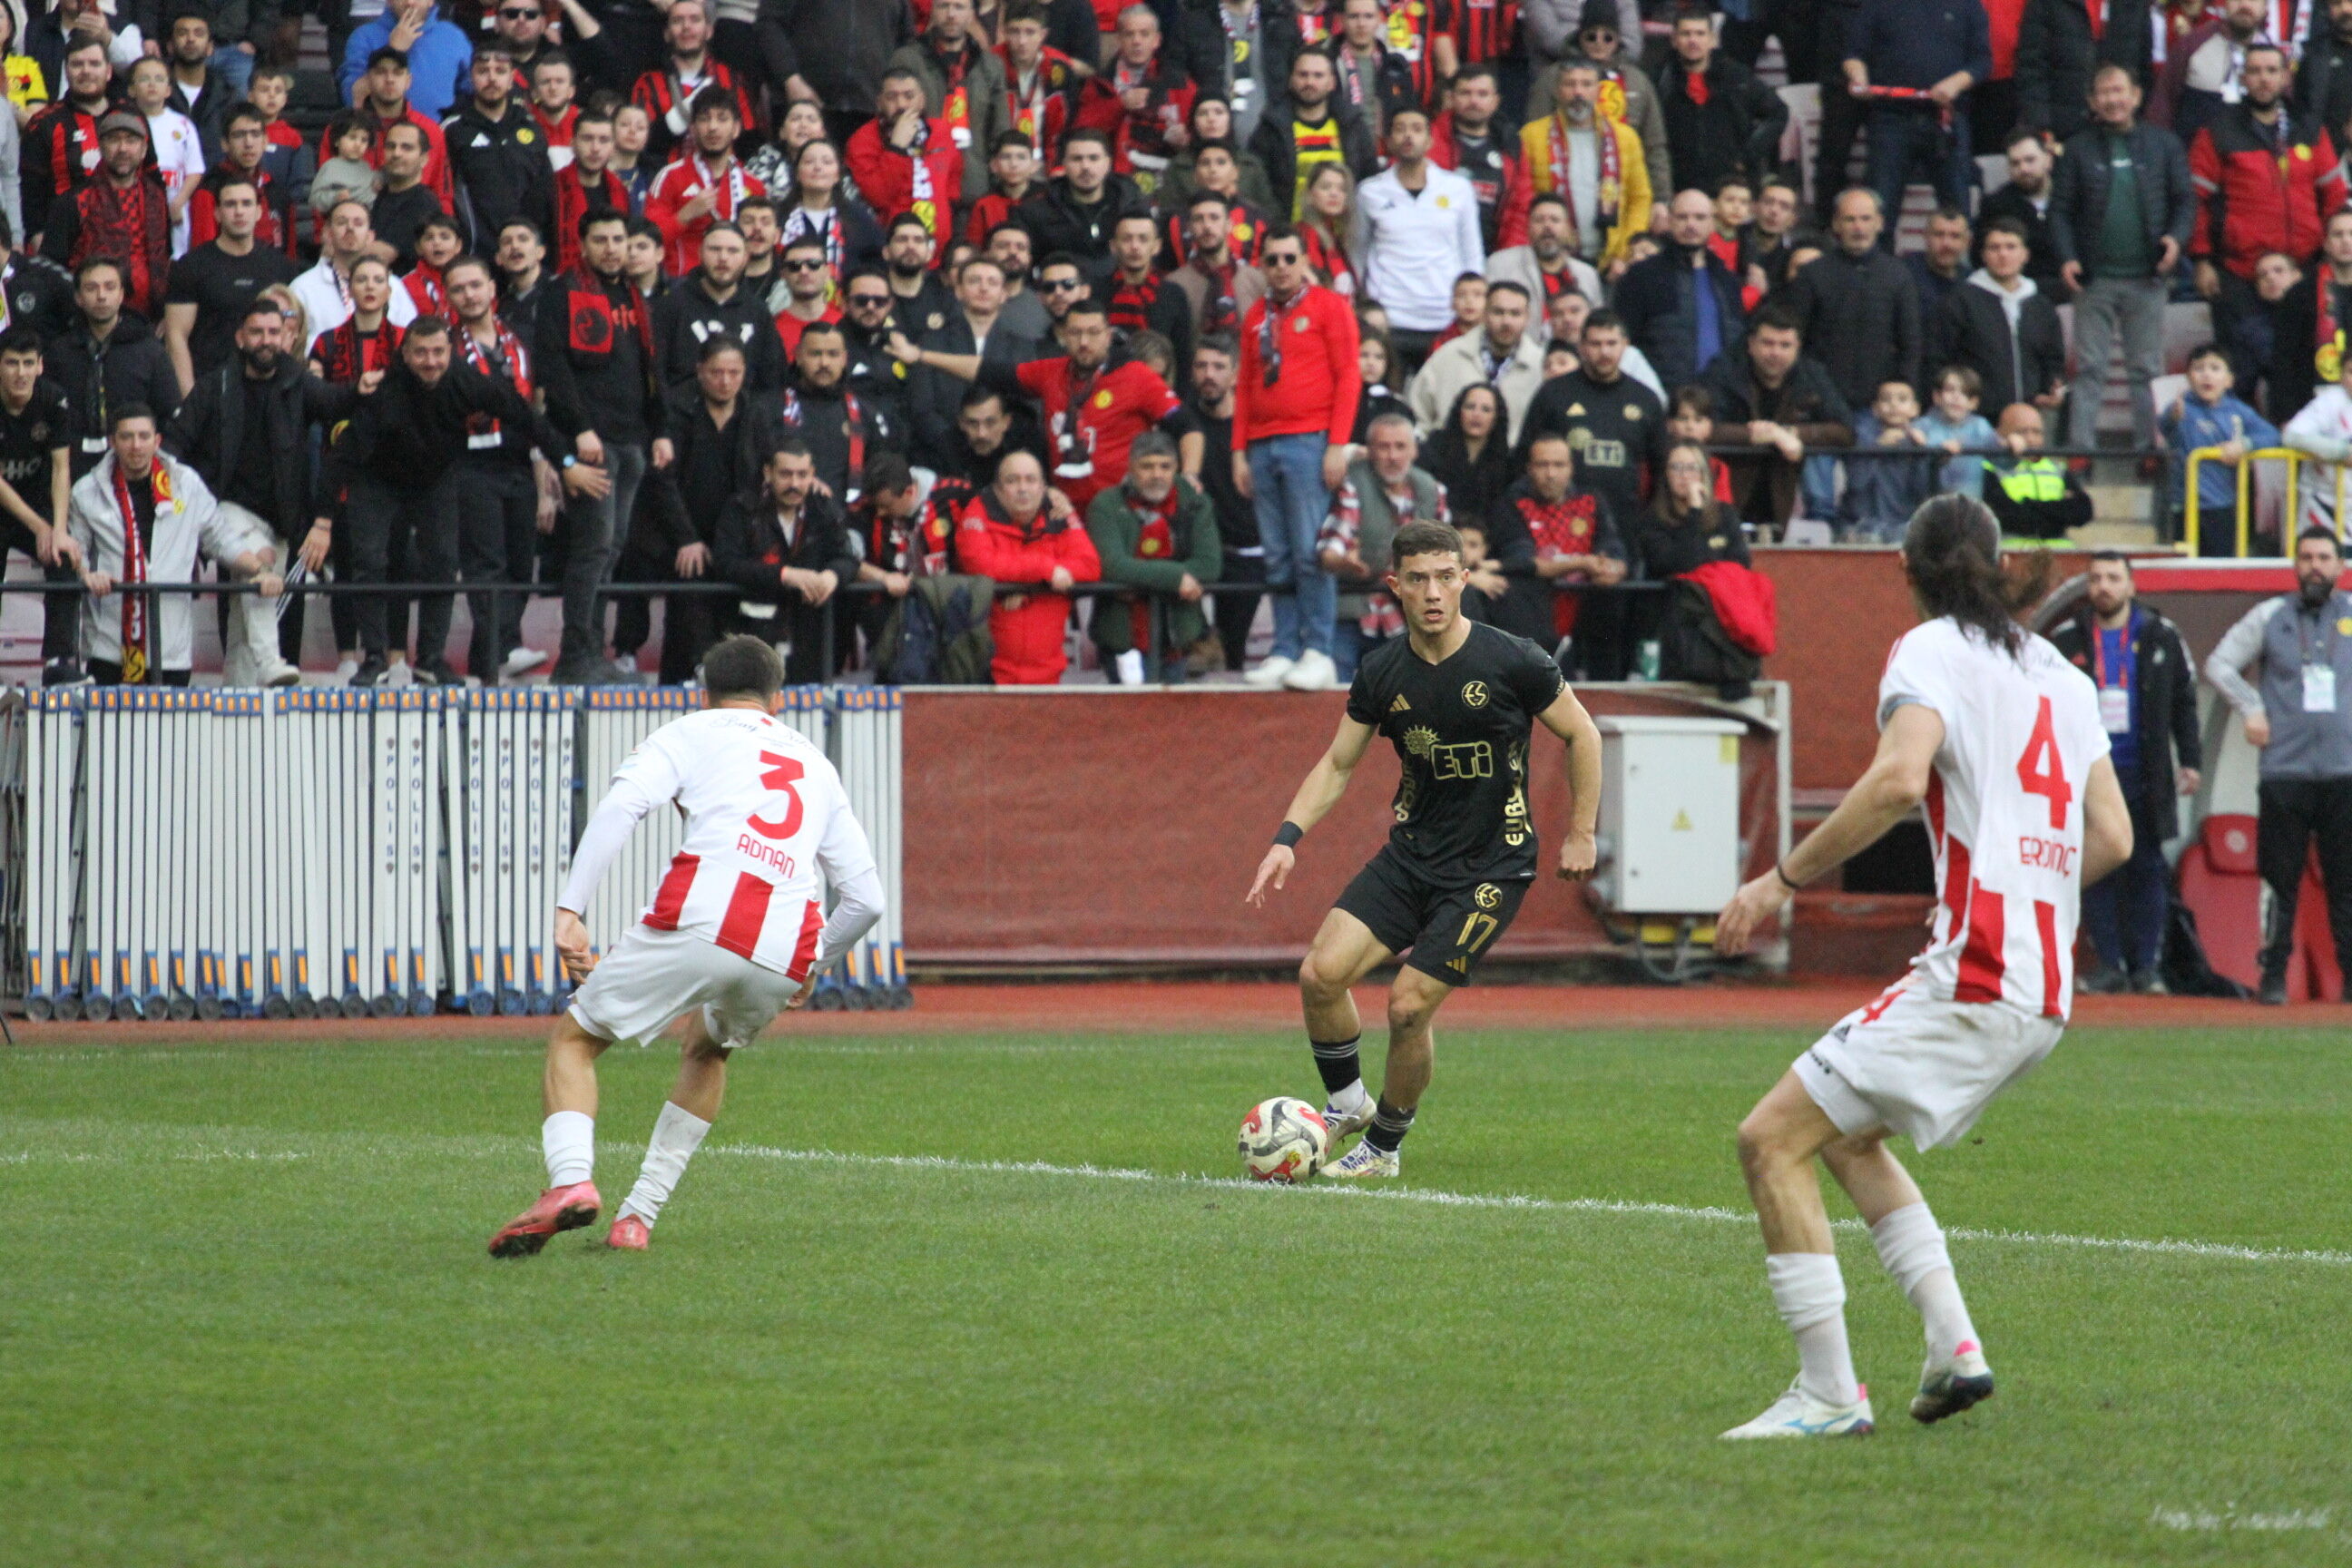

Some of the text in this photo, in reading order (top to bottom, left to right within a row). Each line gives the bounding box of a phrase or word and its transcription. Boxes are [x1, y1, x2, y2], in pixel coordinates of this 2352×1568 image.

[746, 749, 806, 840] 3
[2016, 695, 2073, 830] 4
[736, 833, 796, 879] ADNAN
[1455, 911, 1498, 954] 17
